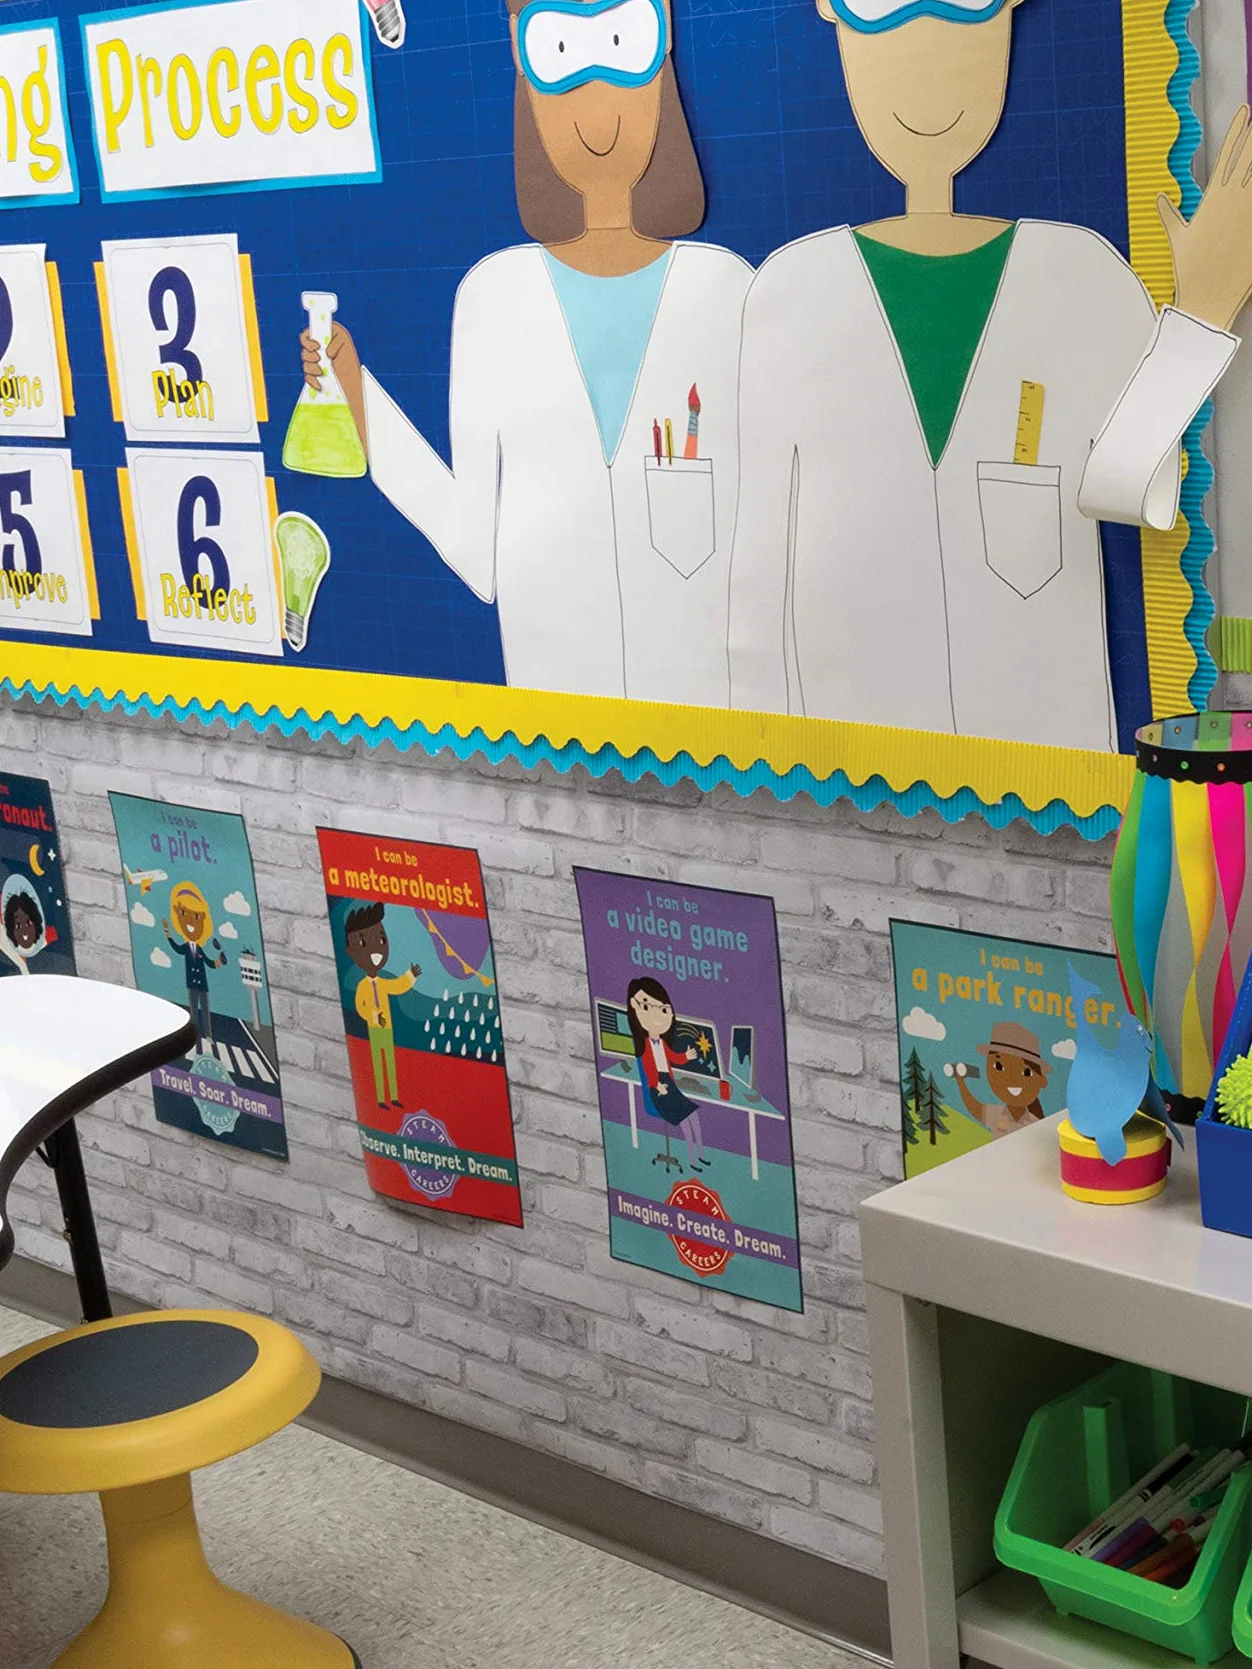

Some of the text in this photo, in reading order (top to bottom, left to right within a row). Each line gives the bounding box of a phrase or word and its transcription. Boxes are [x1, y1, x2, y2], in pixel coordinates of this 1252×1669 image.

[96, 33, 359, 153] Process
[148, 266, 204, 403] 3
[151, 368, 215, 421] Plan
[0, 470, 42, 595] 5
[177, 475, 230, 609] 6
[160, 572, 257, 625] Reflect
[0, 803, 53, 832] onaut.
[168, 813, 184, 827] can
[185, 815, 197, 830] be
[151, 830, 218, 864] a pilot.
[375, 847, 418, 867] I can be
[328, 867, 480, 909] a meteorologist.
[647, 891, 699, 915] I can be
[607, 907, 749, 953] a video game
[630, 940, 729, 983] designer.
[979, 948, 1044, 977] I can be
[911, 967, 928, 992] a
[938, 971, 1003, 1006] park
[159, 1068, 272, 1118] Travel. Soar. Dream.
[406, 1120, 446, 1143] STEAM
[402, 1143, 466, 1172] Interpret.
[468, 1157, 513, 1182] Dream.
[411, 1168, 450, 1191] CAREERS
[675, 1189, 720, 1216] STEAM
[617, 1195, 787, 1260] Imagine. Create. Dream.
[680, 1241, 722, 1268] CAREERS
